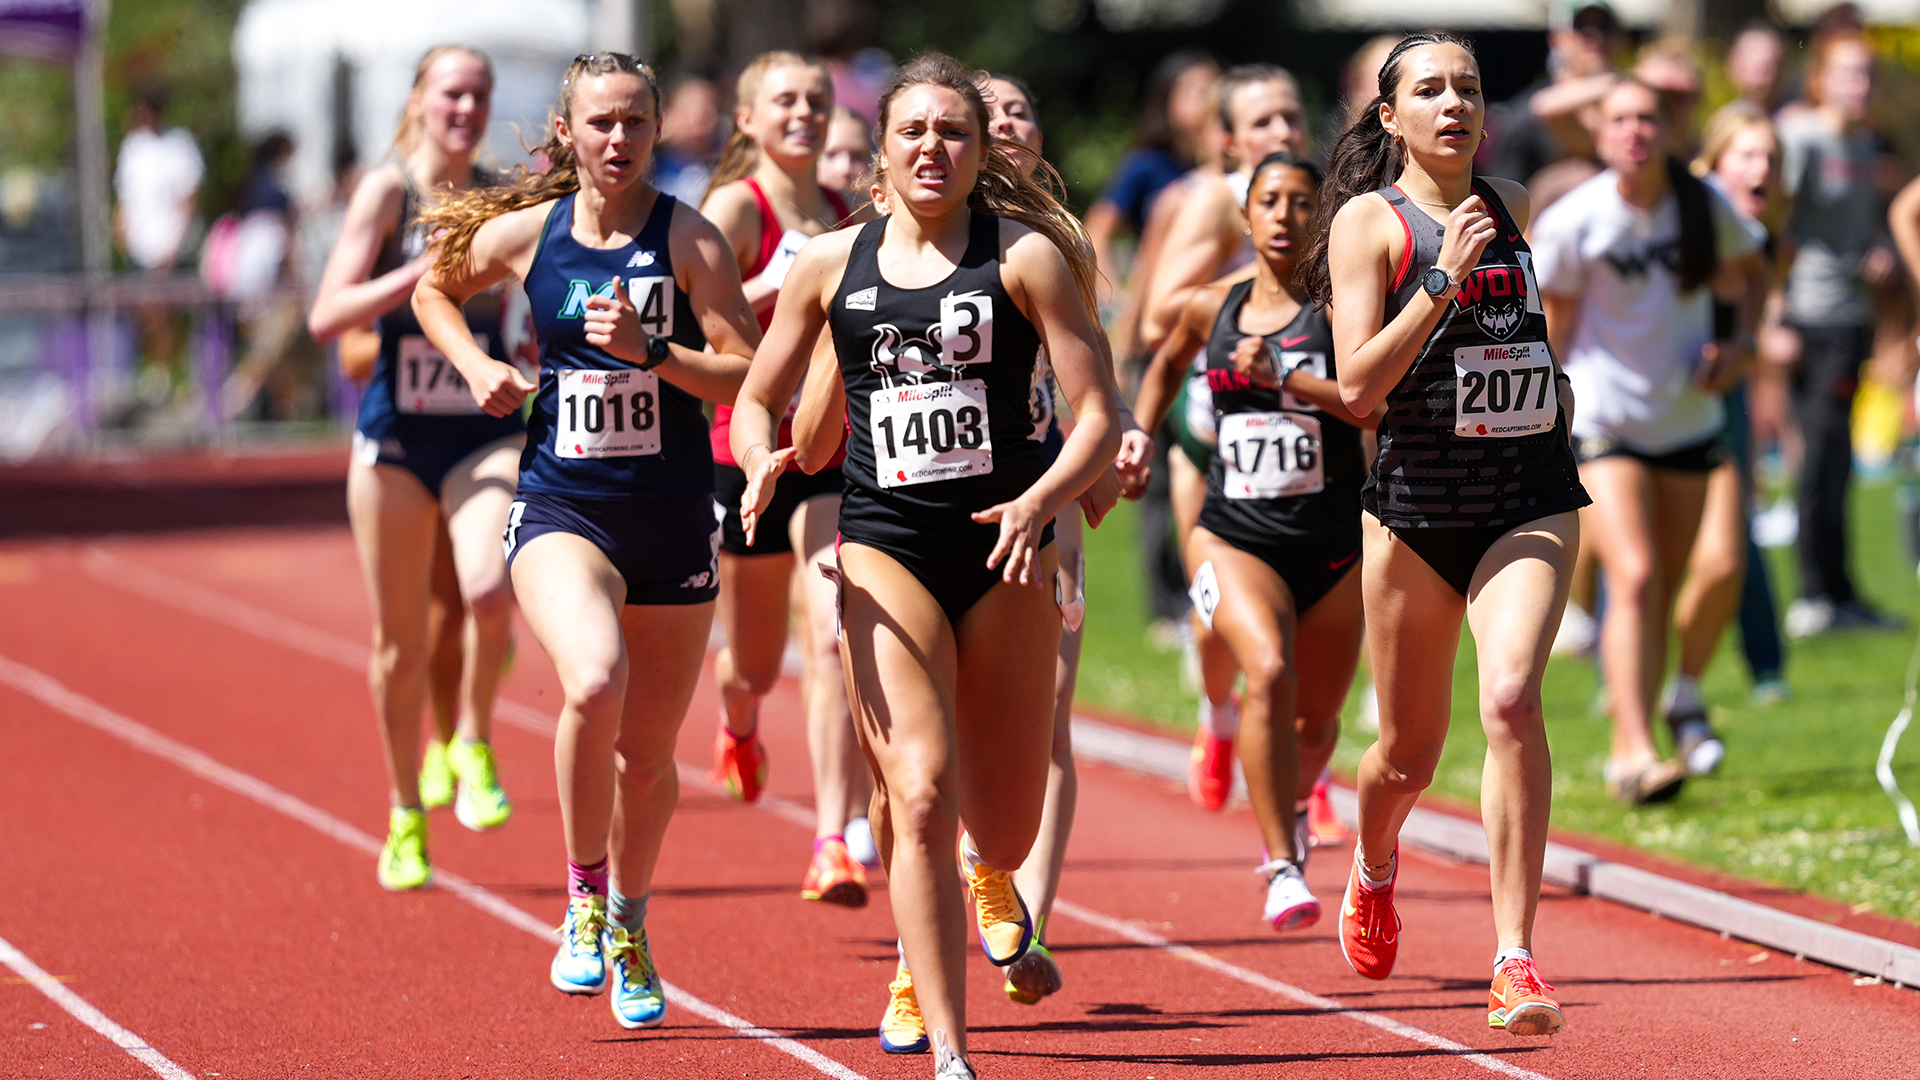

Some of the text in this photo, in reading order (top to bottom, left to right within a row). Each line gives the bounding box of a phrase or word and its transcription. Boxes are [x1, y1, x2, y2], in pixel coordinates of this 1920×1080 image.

[641, 282, 667, 334] 4
[1456, 268, 1527, 308] WOU
[953, 302, 981, 361] 3
[1484, 346, 1530, 361] MileSplit
[582, 372, 630, 386] MileSplit
[897, 385, 953, 402] MileSplit
[1462, 366, 1550, 413] 2077
[565, 391, 655, 433] 1018
[878, 405, 983, 458] 1403
[1491, 423, 1542, 433] REDCAPTIMING.COM
[1229, 434, 1317, 473] 1716
